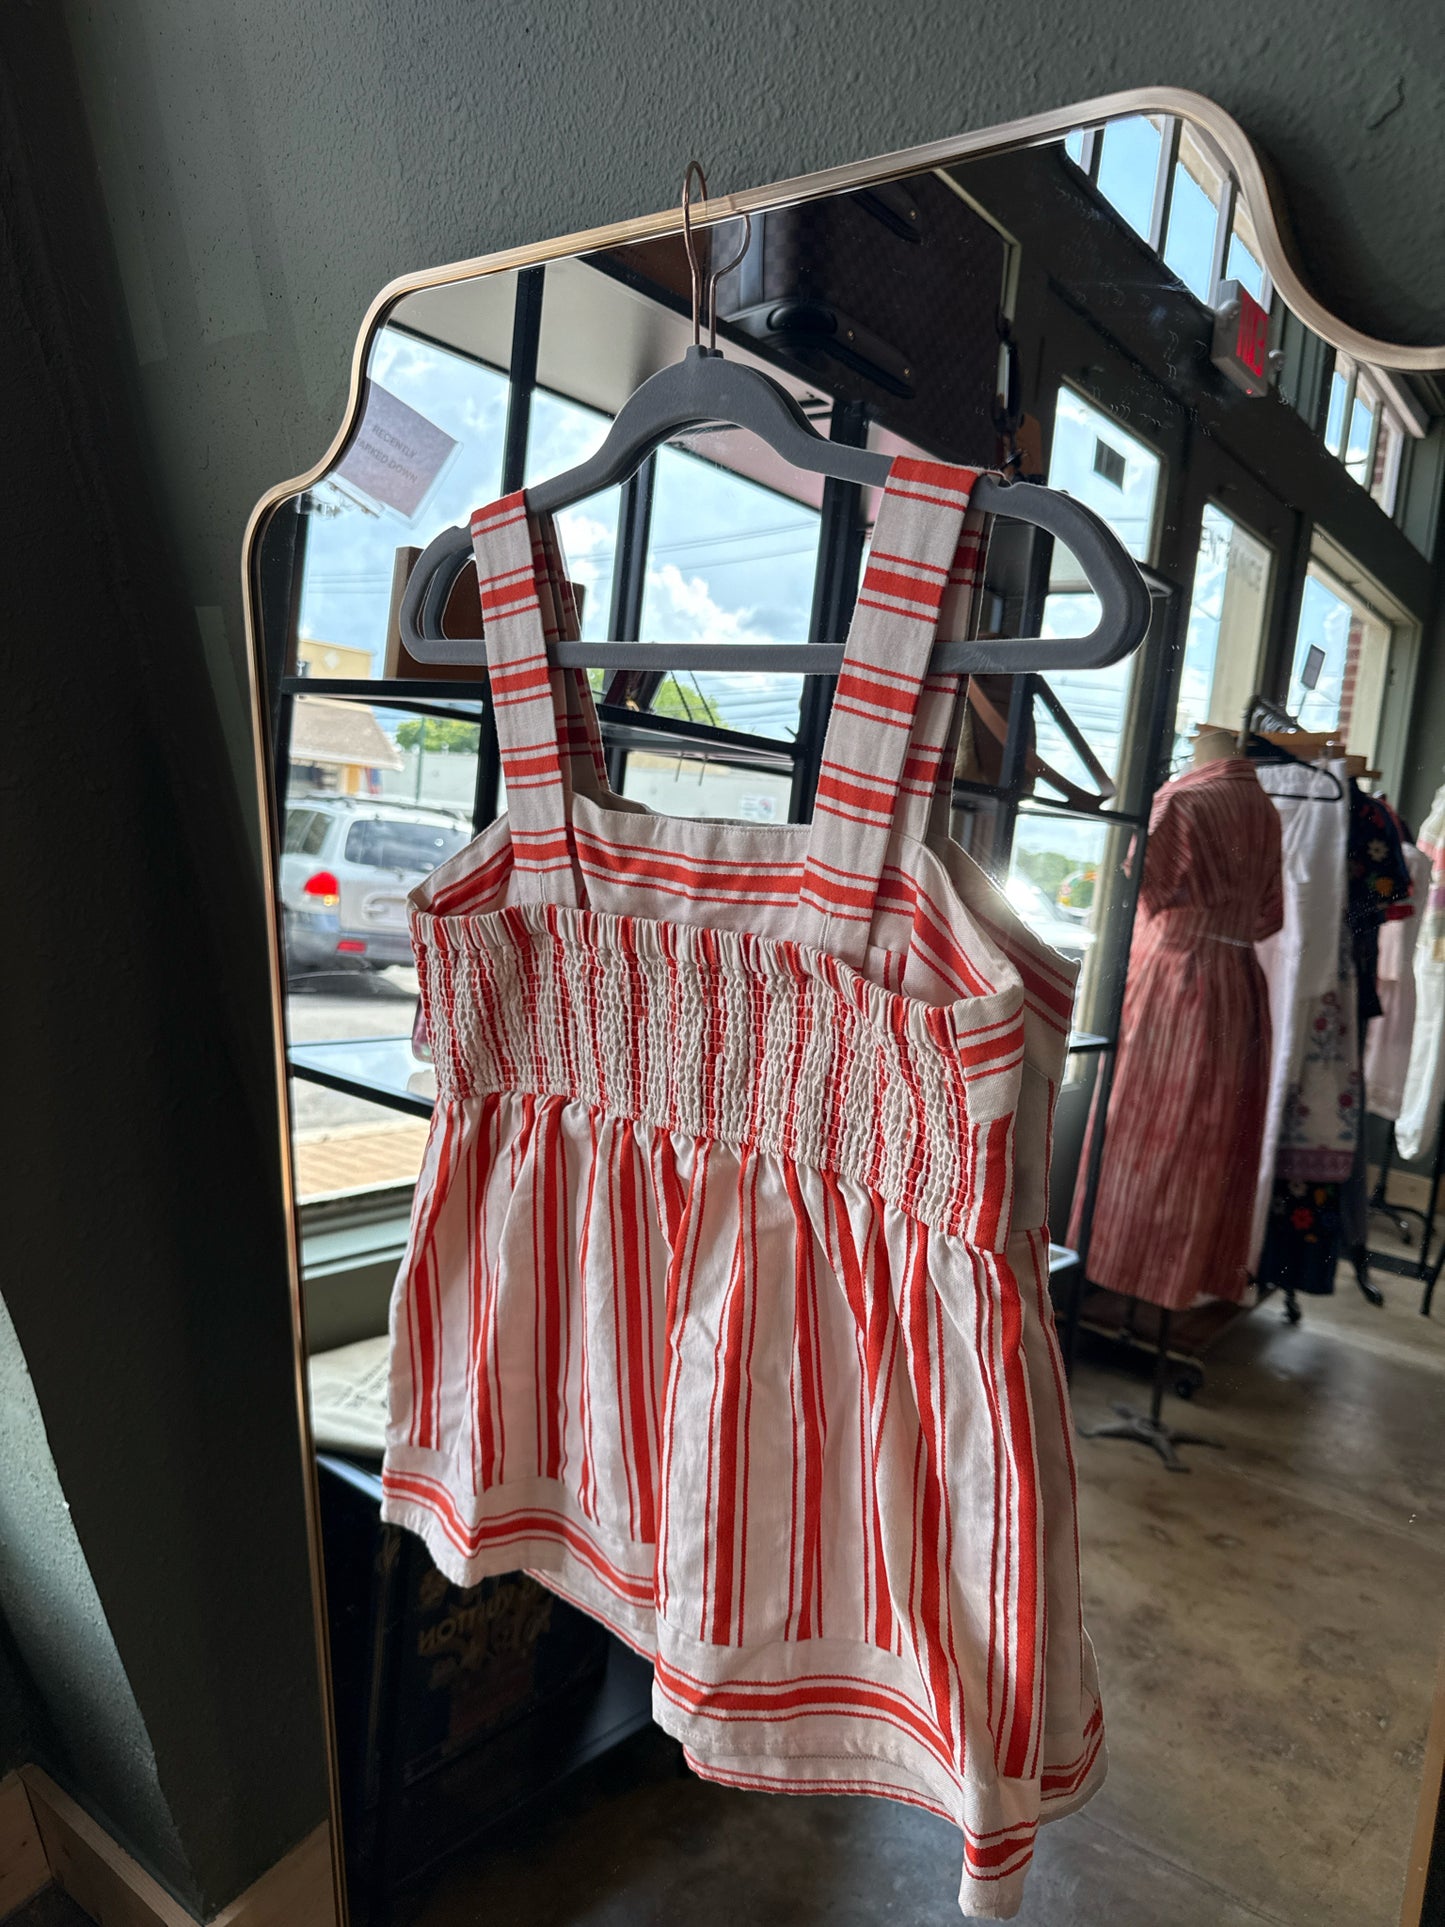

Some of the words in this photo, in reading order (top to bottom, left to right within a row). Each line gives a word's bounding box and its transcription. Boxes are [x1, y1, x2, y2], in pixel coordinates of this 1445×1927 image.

[358, 440, 389, 464] ARKED
[388, 459, 419, 484] DOWN
[371, 425, 418, 460] RECENTLY
